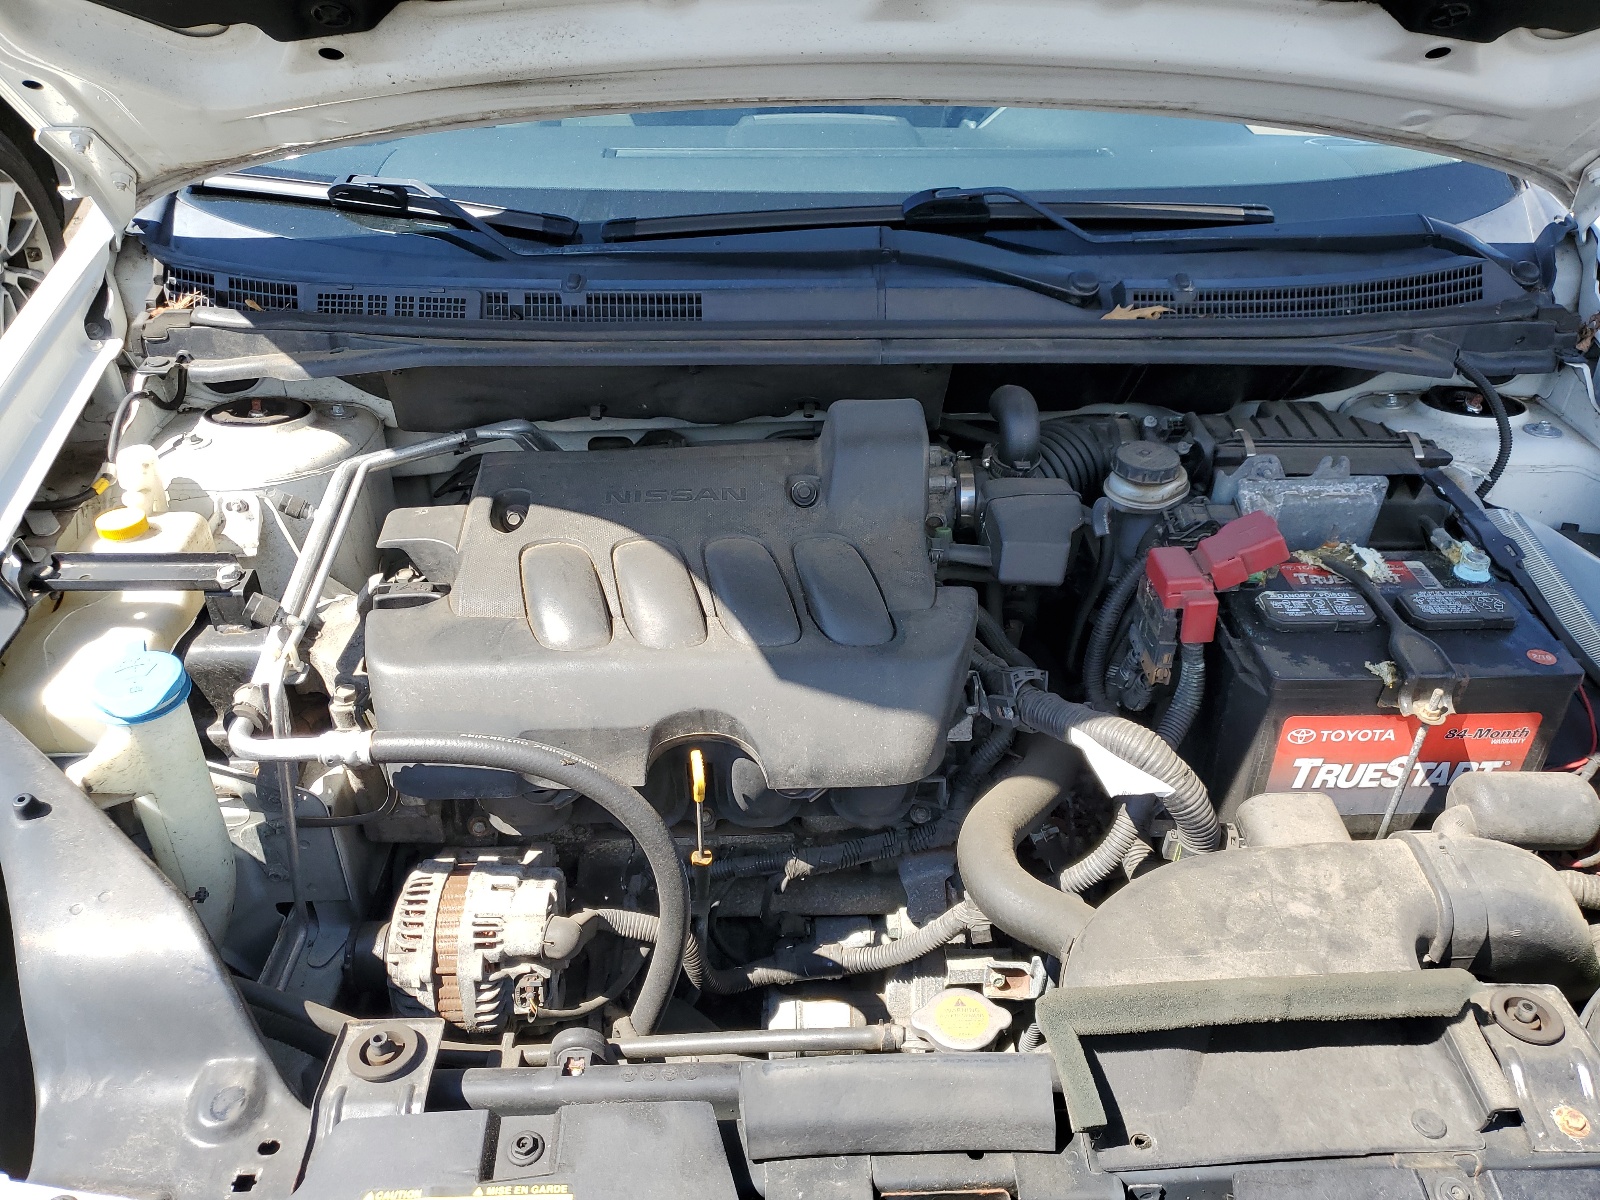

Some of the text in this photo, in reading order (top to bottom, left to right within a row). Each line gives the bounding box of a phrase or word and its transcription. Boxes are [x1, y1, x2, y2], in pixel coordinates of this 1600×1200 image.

[604, 487, 747, 504] NISSAN
[1320, 728, 1396, 742] TOYOTA
[1444, 727, 1530, 740] 84-Month
[375, 1189, 422, 1200] CAUTION
[486, 1184, 568, 1195] MISE EN GARDE
